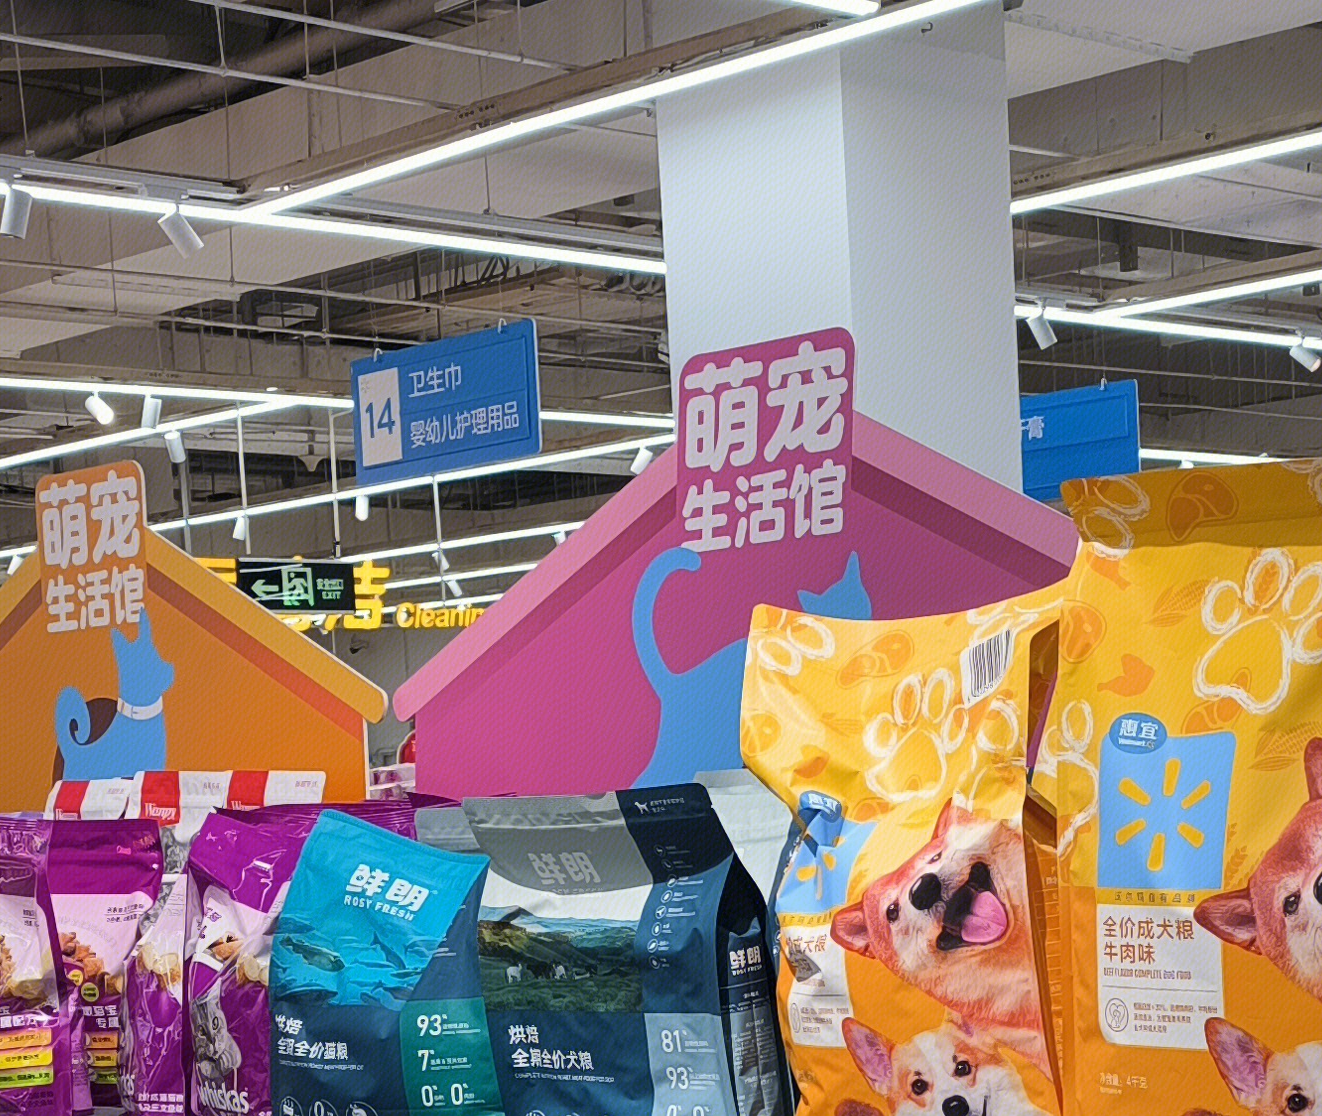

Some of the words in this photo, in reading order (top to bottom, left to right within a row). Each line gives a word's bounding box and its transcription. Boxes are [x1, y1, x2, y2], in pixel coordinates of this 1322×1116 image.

[407, 363, 463, 399] 卫生巾
[364, 402, 395, 439] 14
[410, 400, 520, 449] 婴幼儿护理用品
[684, 341, 849, 472] 萌宠
[40, 471, 140, 570] 萌宠
[682, 460, 846, 552] 生活馆
[46, 564, 145, 633] 生活馆
[321, 591, 341, 599] EXIT
[1119, 718, 1159, 739] 惠宜
[527, 851, 601, 887] 鲜朗
[345, 864, 429, 912] 鲜朗
[344, 894, 373, 911] ROSY
[374, 899, 415, 921] FRESH
[1102, 917, 1195, 941] 全价成犬粮
[729, 945, 762, 969] 鲜朗
[1103, 942, 1156, 965] 牛肉味
[508, 1024, 539, 1045] 烘焙
[198, 1082, 250, 1114] whiskas
